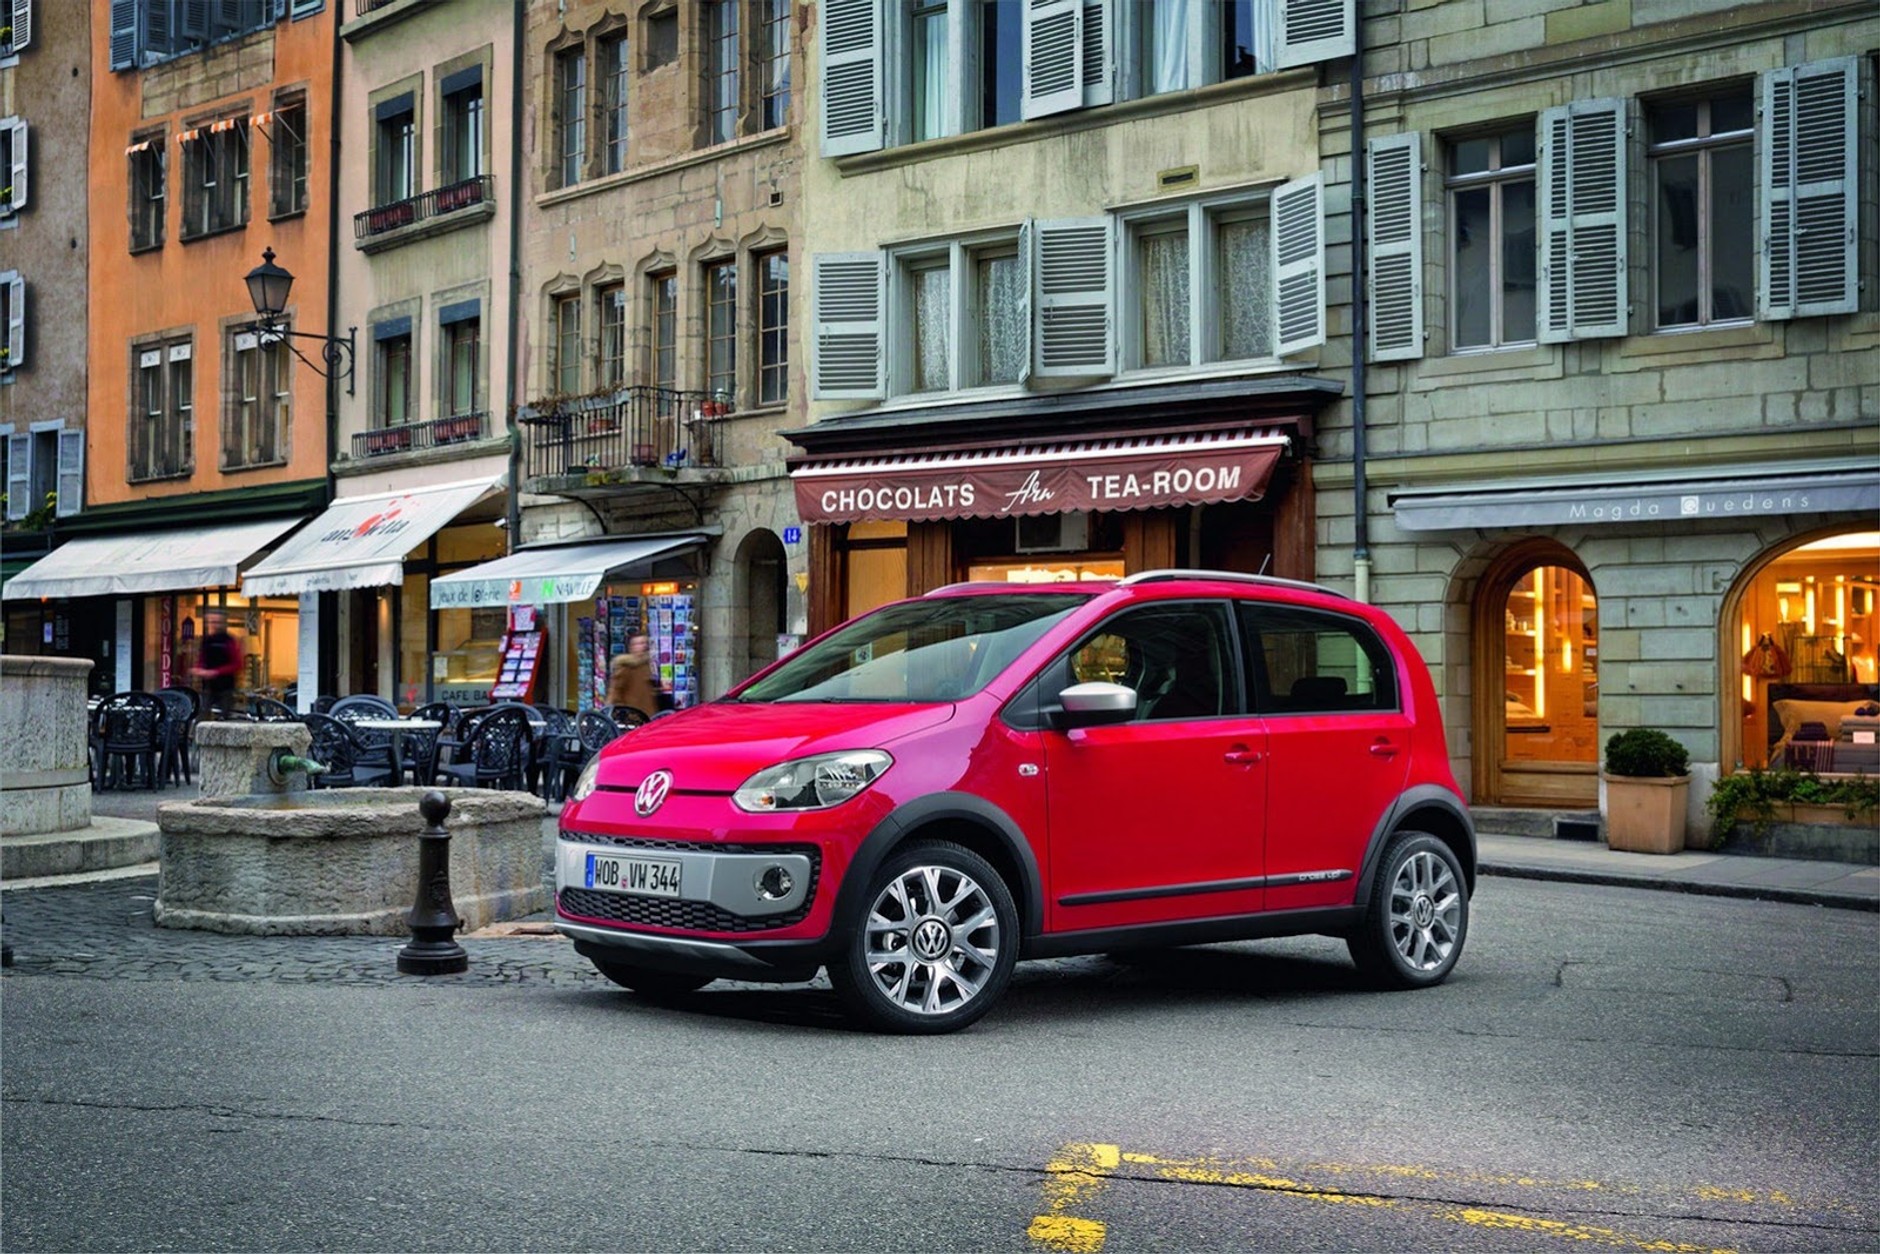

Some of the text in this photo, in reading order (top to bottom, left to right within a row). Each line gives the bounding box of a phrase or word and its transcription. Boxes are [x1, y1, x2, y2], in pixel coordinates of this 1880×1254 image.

[820, 483, 976, 513] CHOCOLATS
[1086, 466, 1241, 499] TEA-ROOM
[1569, 500, 1660, 520] Magda
[786, 529, 798, 541] 14
[437, 590, 455, 606] jeux
[458, 587, 468, 601] de
[441, 689, 469, 701] CAFE
[595, 860, 678, 892] WOB VW 344
